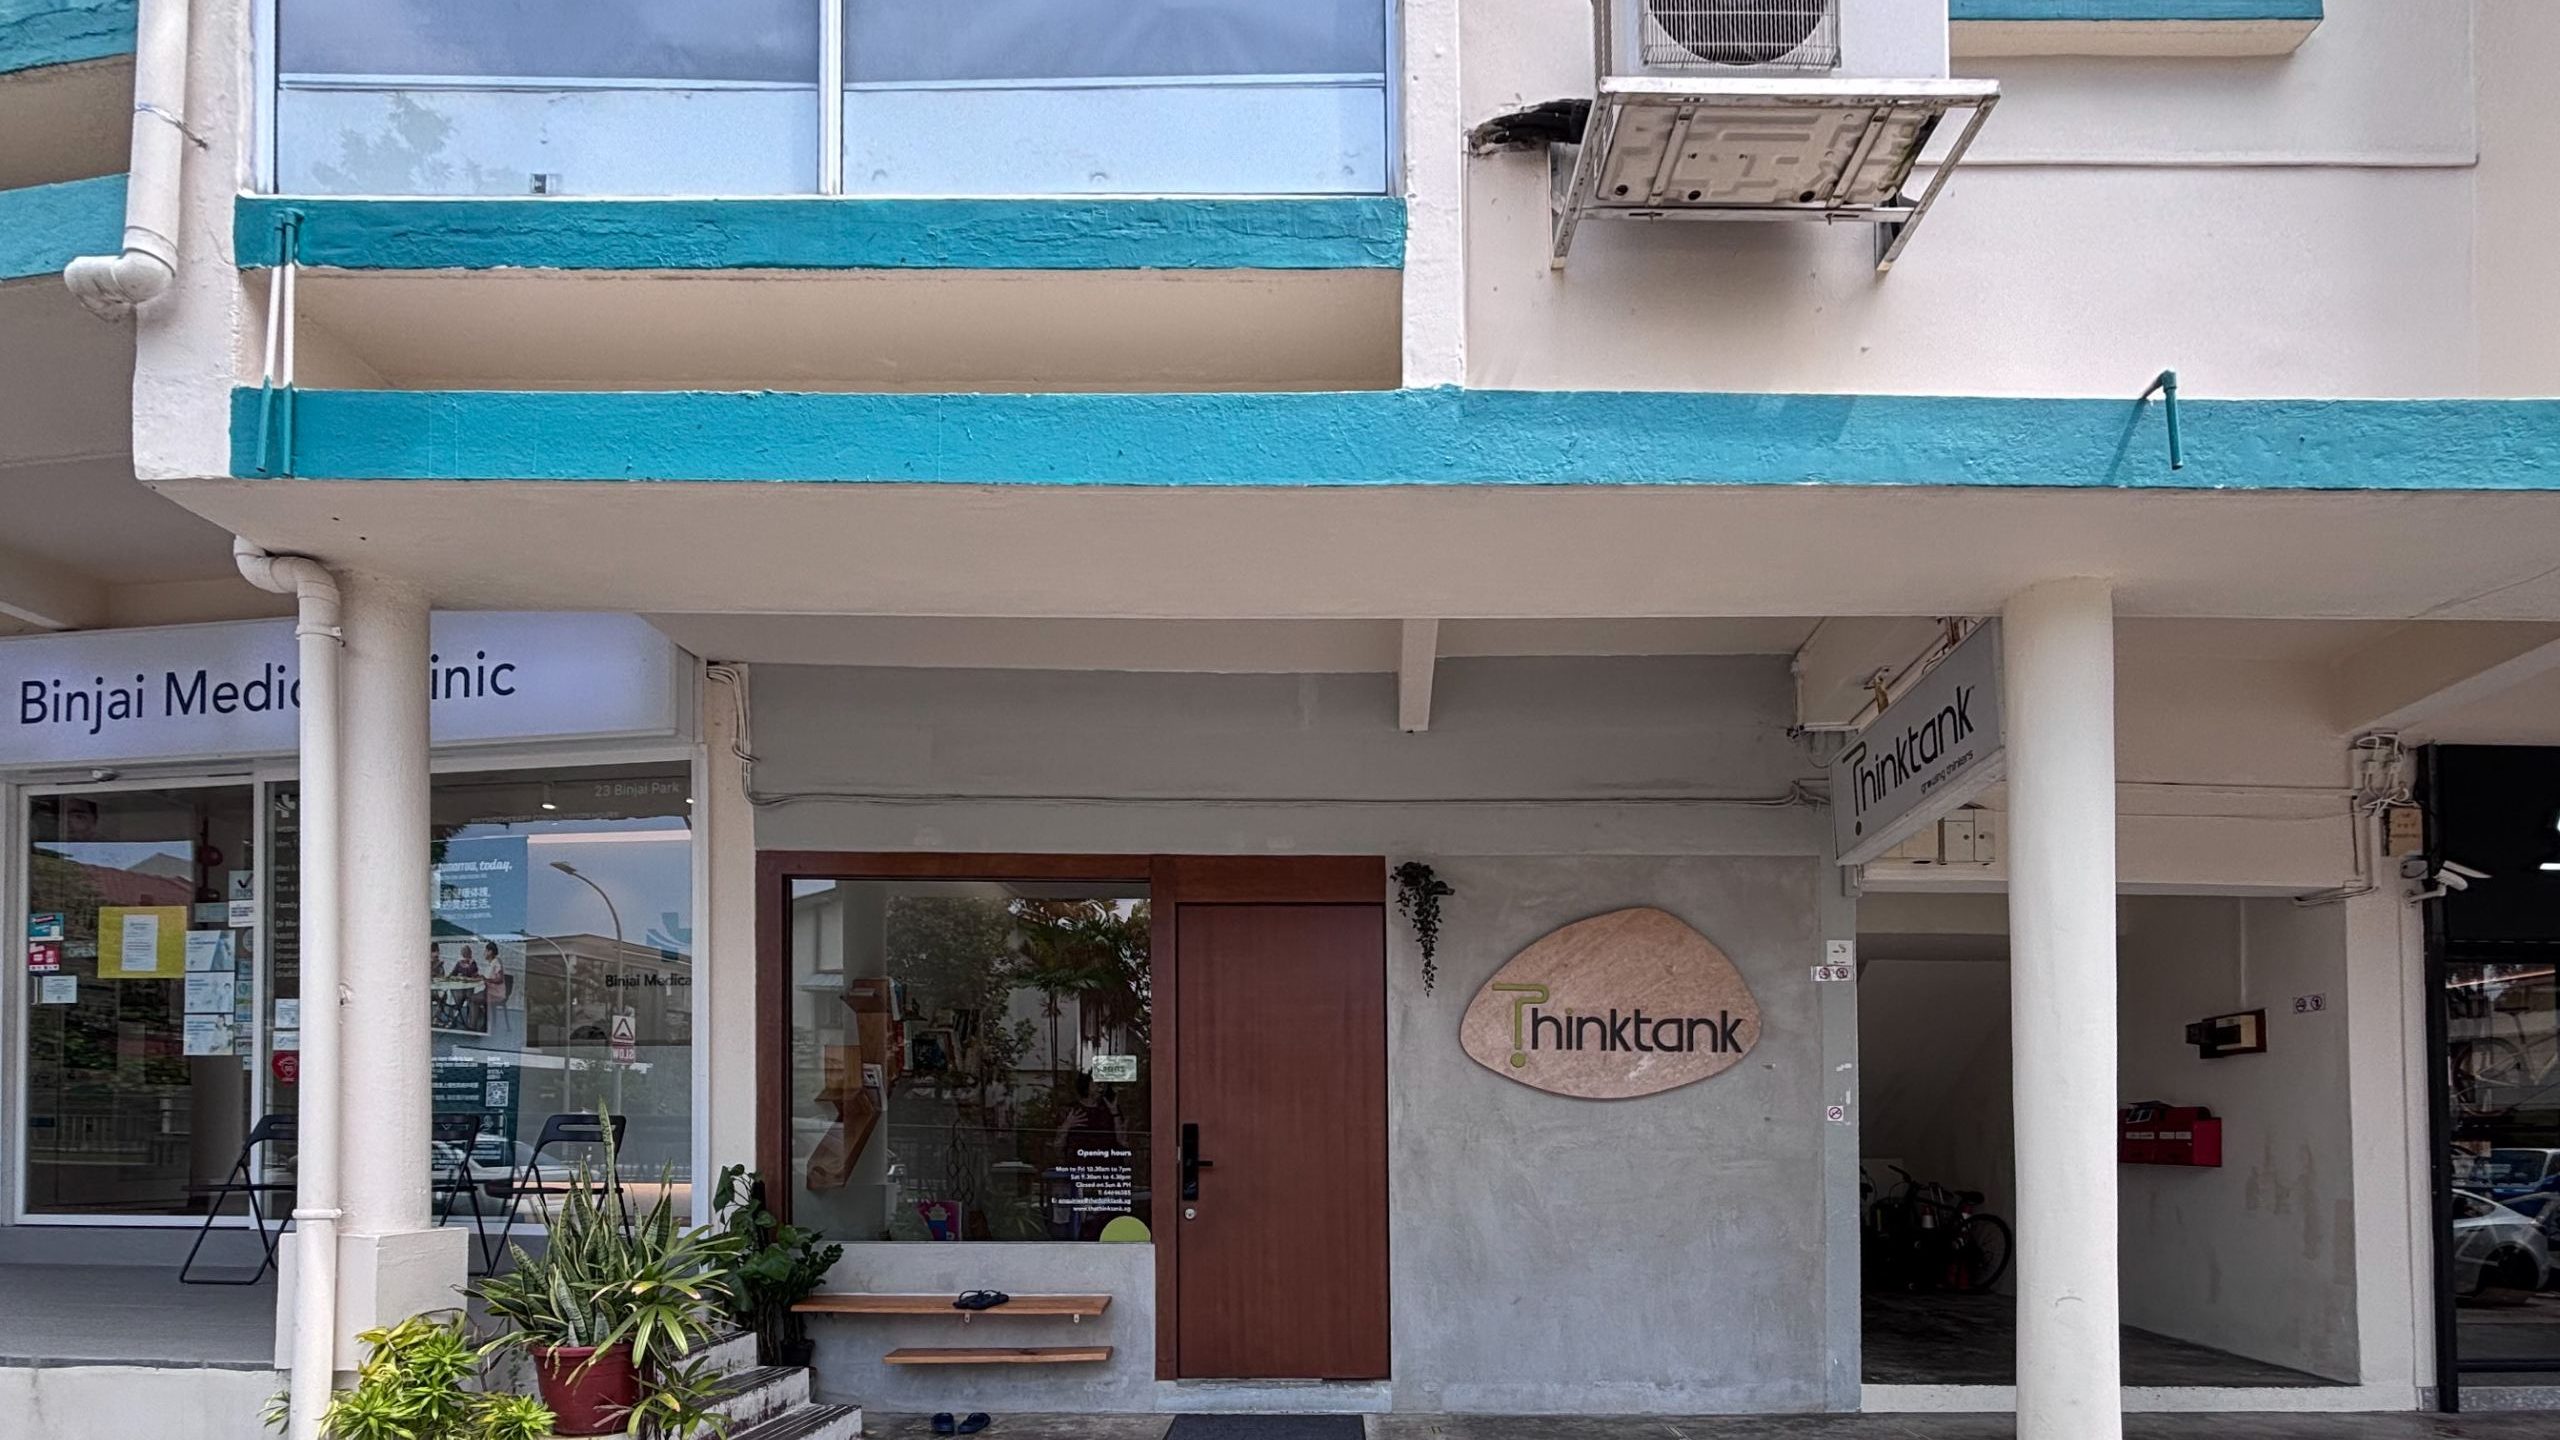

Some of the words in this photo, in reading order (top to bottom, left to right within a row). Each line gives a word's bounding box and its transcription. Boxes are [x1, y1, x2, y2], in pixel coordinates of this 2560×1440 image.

[20, 674, 144, 734] Binjai
[1842, 684, 1975, 836] Thinktank
[595, 784, 610, 797] 23
[614, 783, 648, 798] Binjai
[651, 782, 680, 794] Park
[605, 973, 640, 990] Binjai
[1492, 982, 1744, 1068] Thinktank
[1077, 1148, 1109, 1158] Opening
[1110, 1148, 1131, 1156] hours
